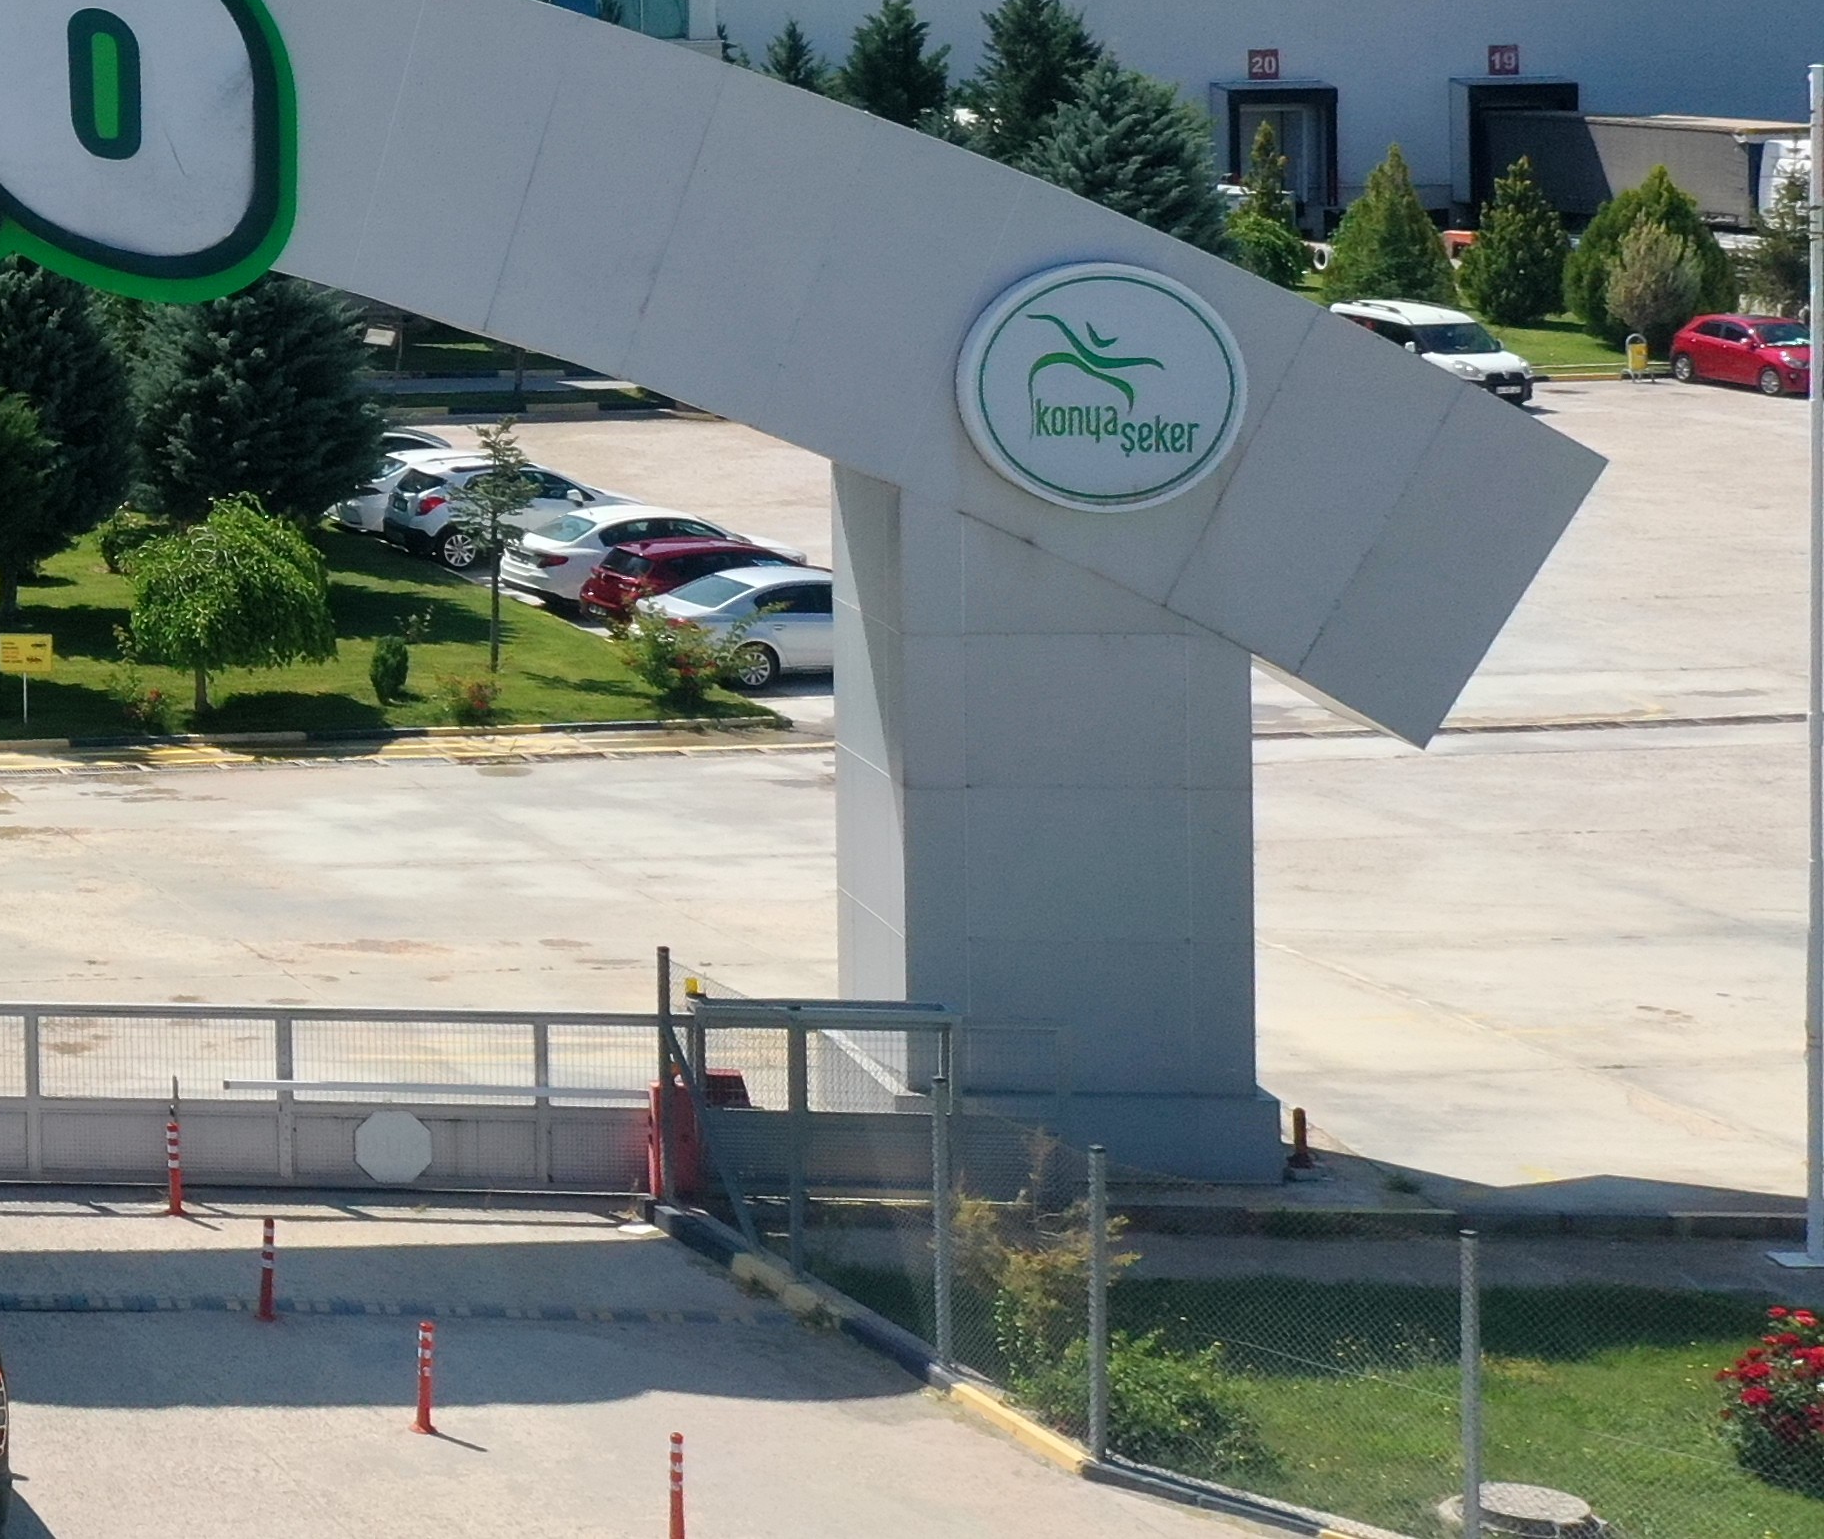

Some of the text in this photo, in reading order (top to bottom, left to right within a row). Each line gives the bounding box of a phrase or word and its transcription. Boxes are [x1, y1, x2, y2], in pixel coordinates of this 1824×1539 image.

[1252, 56, 1276, 73] 20
[1491, 51, 1516, 70] 19
[1035, 397, 1200, 458] konya şeker
